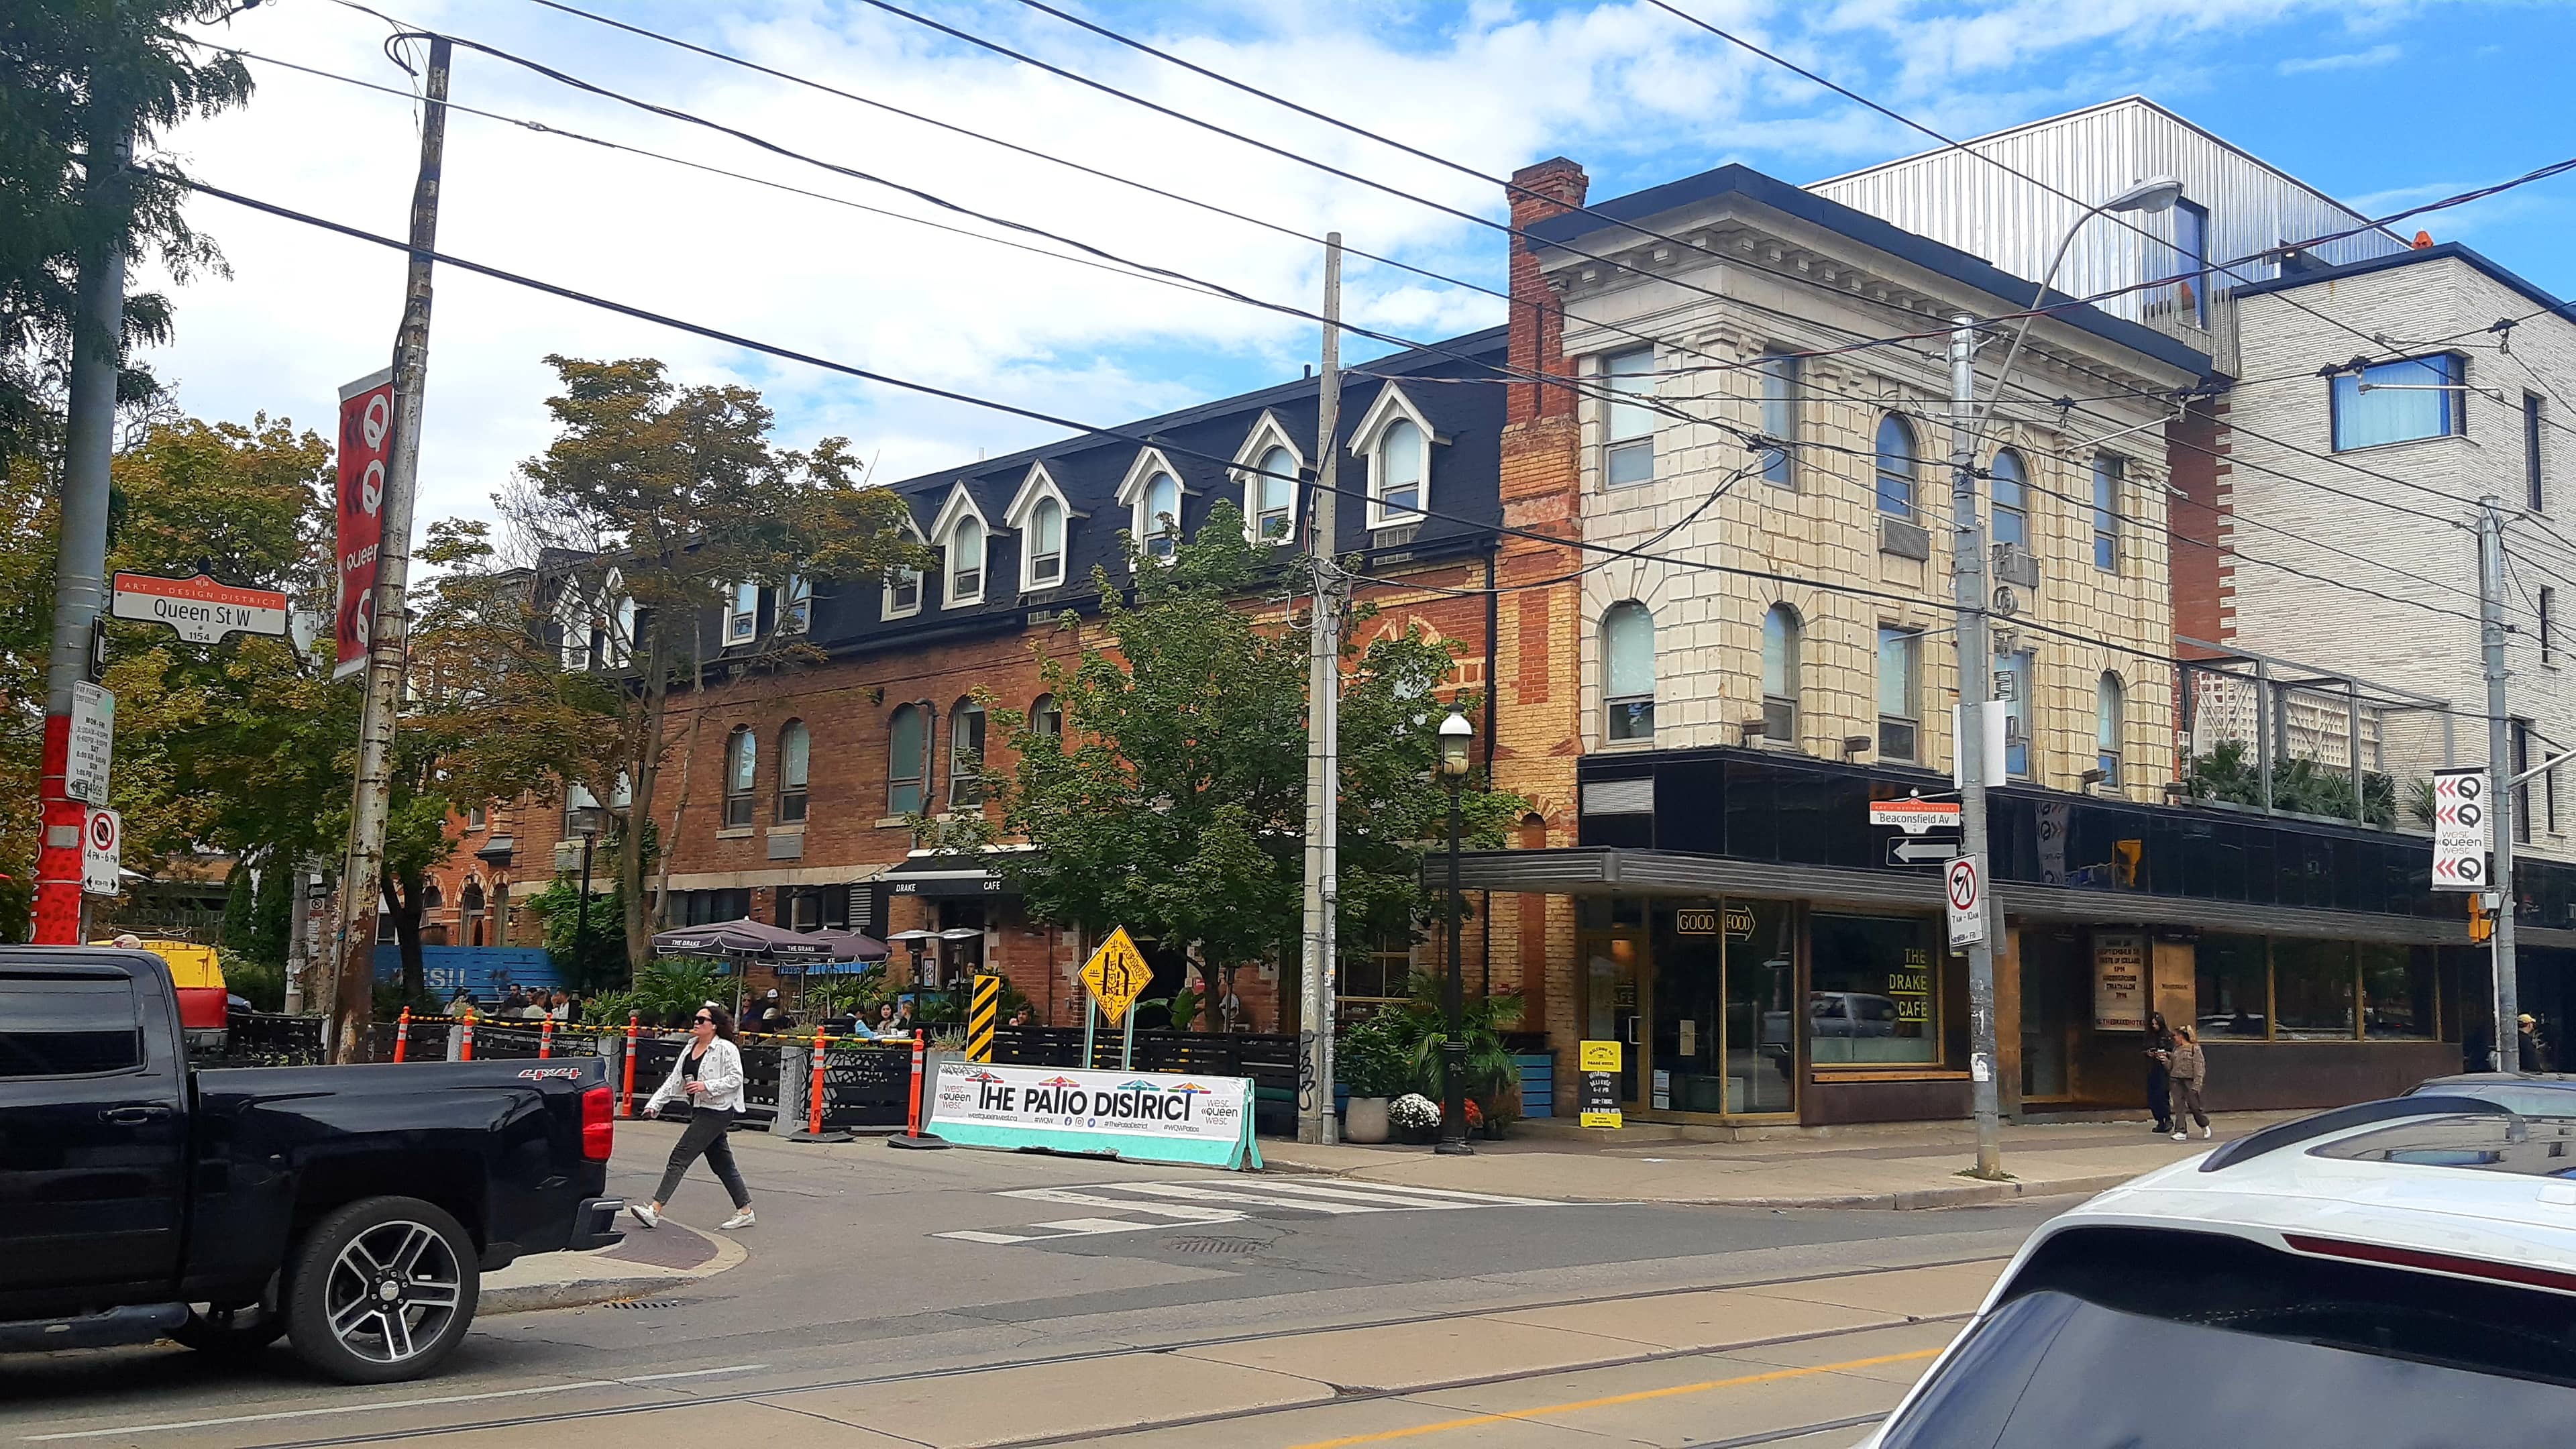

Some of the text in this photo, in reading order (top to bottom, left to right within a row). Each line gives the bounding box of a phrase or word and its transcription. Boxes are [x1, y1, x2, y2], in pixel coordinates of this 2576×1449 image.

[124, 583, 148, 591] ART
[168, 587, 214, 598] DESIGN
[221, 593, 276, 606] DISTRICT
[154, 598, 251, 627] Queen St W
[189, 631, 210, 641] 1154
[2457, 776, 2481, 801] Q
[1880, 812, 1949, 824] Beaconsfield Av
[2457, 804, 2481, 828] Q
[2441, 830, 2469, 839] west
[87, 849, 91, 860] 4
[92, 851, 100, 861] PM
[105, 852, 109, 863] 6
[110, 855, 117, 863] PM
[2442, 847, 2469, 855] west
[2457, 857, 2482, 882] Q
[896, 881, 1001, 892] DRAKE CAFE
[1680, 914, 1750, 930] GOOD FOOD
[1905, 949, 1927, 964] THE
[1889, 973, 1927, 990] DRAKE
[945, 1085, 964, 1093] west
[943, 1102, 961, 1110] west
[977, 1077, 1191, 1121] THE PATIO DISTRICT
[1207, 1099, 1230, 1108] west
[968, 1112, 1018, 1122] westqueenwest.ca
[1104, 1121, 1148, 1129] #ThePatioDistrict
[1163, 1124, 1199, 1132] #WQWPatios
[1205, 1116, 1228, 1125] west
